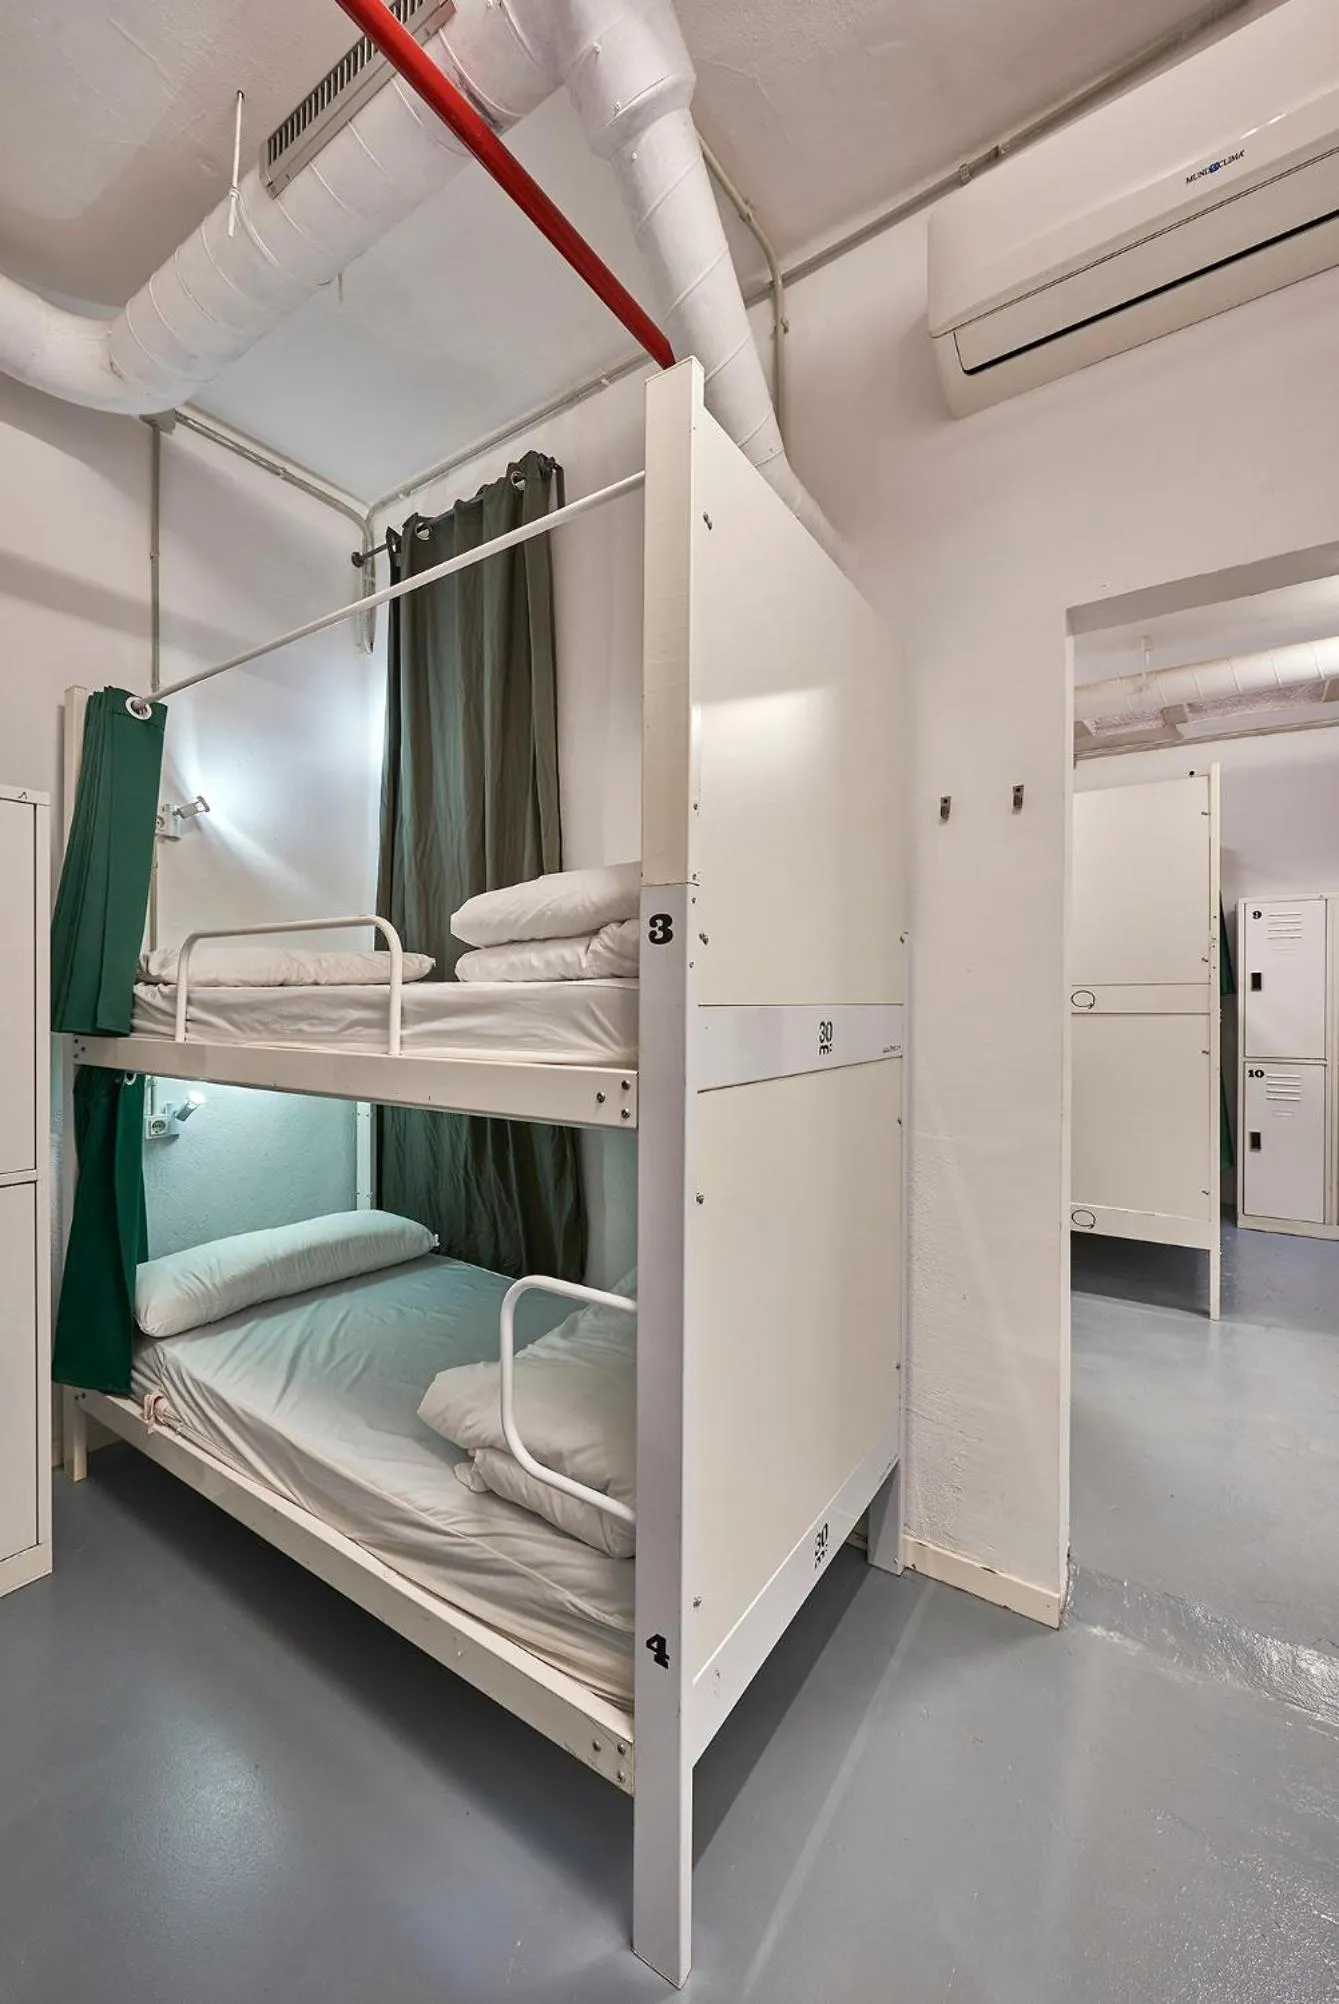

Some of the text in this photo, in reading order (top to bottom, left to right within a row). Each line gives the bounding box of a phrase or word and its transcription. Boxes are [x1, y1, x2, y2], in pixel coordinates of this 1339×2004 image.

[1252, 910, 1262, 920] 9
[648, 913, 673, 945] 3
[819, 1021, 833, 1043] 30
[1248, 1069, 1265, 1078] 10
[646, 1633, 670, 1670] 4
